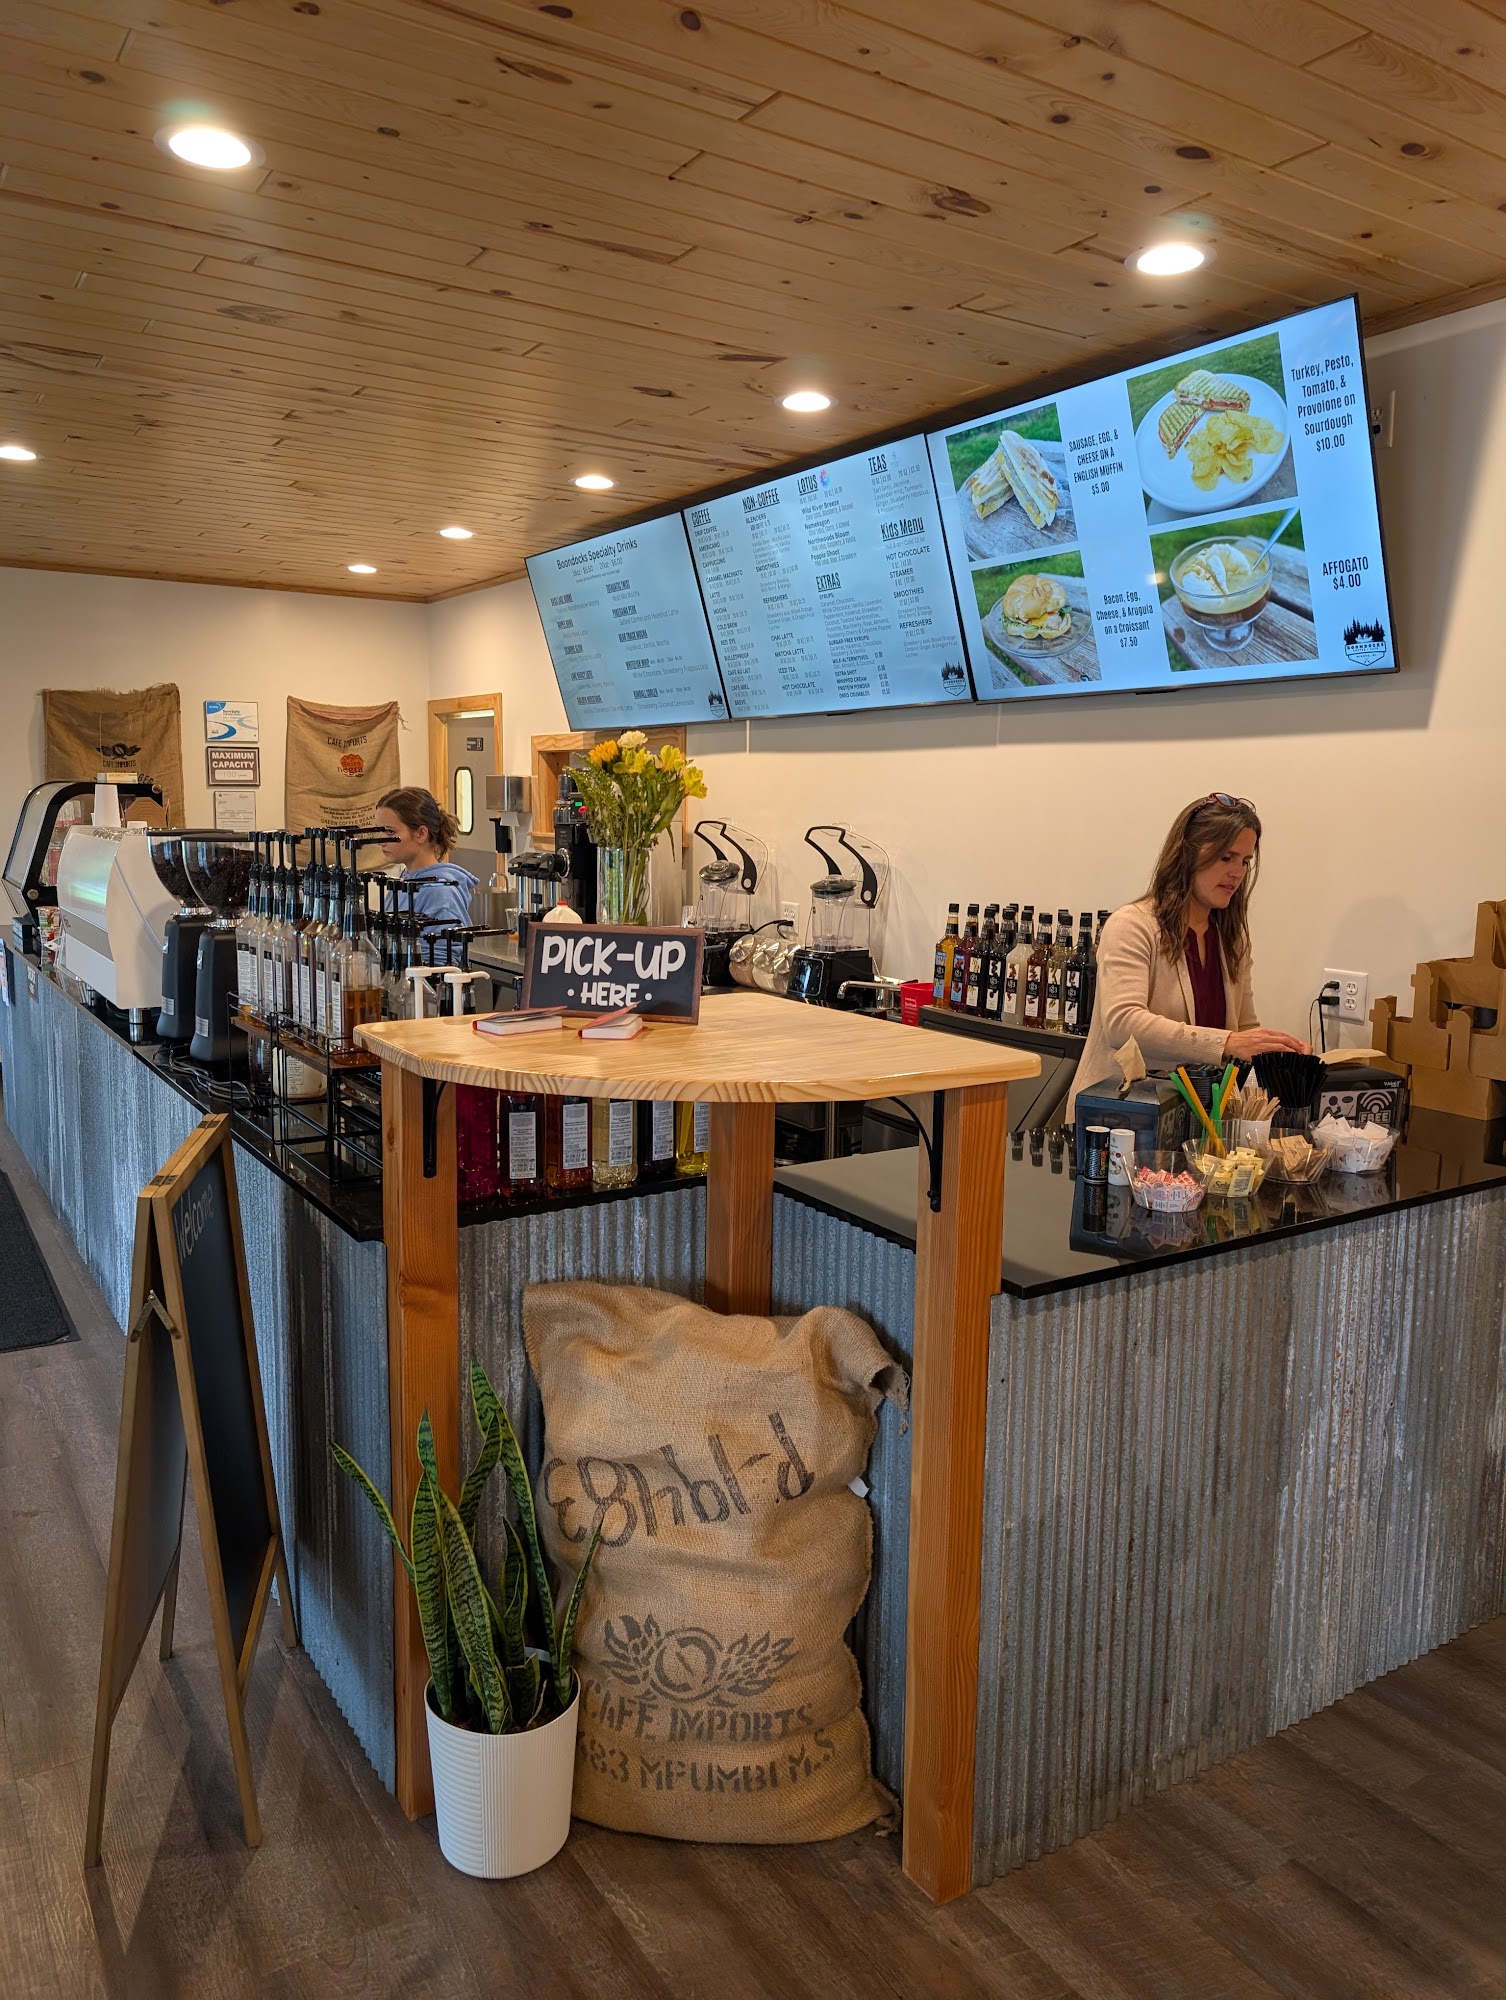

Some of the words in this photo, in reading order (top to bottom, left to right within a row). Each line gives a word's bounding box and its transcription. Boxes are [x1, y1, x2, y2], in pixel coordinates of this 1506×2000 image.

[1291, 361, 1323, 383] Turkey,
[1325, 353, 1353, 374] Pesto,
[1302, 376, 1338, 398] Tomato,
[1339, 374, 1346, 389] &
[1298, 396, 1341, 417] Provolone
[1344, 392, 1355, 406] on
[1304, 412, 1352, 436] Sourdough
[1068, 434, 1097, 452] SAUSAGE,
[1098, 430, 1112, 444] EGG,
[1112, 428, 1118, 441] &
[1316, 433, 1344, 451] $10.00
[868, 454, 886, 472] TEAS
[1077, 450, 1098, 465] CHEESE
[1100, 448, 1108, 459] ON
[1109, 446, 1114, 457] A
[1074, 467, 1098, 482] ENGLISH
[1099, 461, 1123, 476] MUFFIN
[796, 474, 817, 493] LOTUS
[1091, 481, 1109, 495] $5.00
[742, 488, 779, 510] NON-COFFEE
[812, 503, 823, 511] River
[824, 499, 839, 508] Breeze
[691, 508, 710, 524] COFFEE
[703, 526, 716, 534] COFFEE
[880, 521, 898, 538] Kids
[899, 515, 923, 534] Menu
[808, 534, 834, 545] Northwoods
[835, 530, 849, 538] Bloom
[556, 552, 588, 570] Boondocks
[588, 544, 616, 562] Specialty
[616, 538, 638, 554] Drinks
[698, 542, 720, 551] AMERICANO
[897, 546, 929, 558] CHOCOLATE
[889, 568, 913, 577] STEAMER
[1322, 556, 1368, 575] AFFOGATO
[816, 572, 840, 589] EXTRAS
[1332, 573, 1361, 590] $4.00
[893, 587, 923, 597] SMOOTHIES
[1103, 592, 1125, 605] Bacon,
[1126, 590, 1140, 602] Egg,
[1096, 608, 1121, 621] Cheese,
[1121, 607, 1126, 618] &
[1127, 603, 1153, 617] Arugula
[899, 618, 932, 628] REFRESHERS
[1104, 624, 1112, 634] on
[1113, 623, 1117, 633] a
[1118, 620, 1149, 632] Croissant
[1119, 636, 1137, 647] $7.50
[328, 737, 342, 748] CAFE
[343, 736, 368, 748] IMPORTS
[103, 760, 115, 768] CAFE
[116, 760, 136, 768] IMPORTS
[212, 752, 254, 760] MAXIMUM
[541, 936, 686, 980] PICK-UP
[580, 982, 640, 1007] HERE
[1361, 1112, 1389, 1123] FREE
[174, 1184, 214, 1266] Welcome
[669, 1703, 814, 1743] IMPORTS
